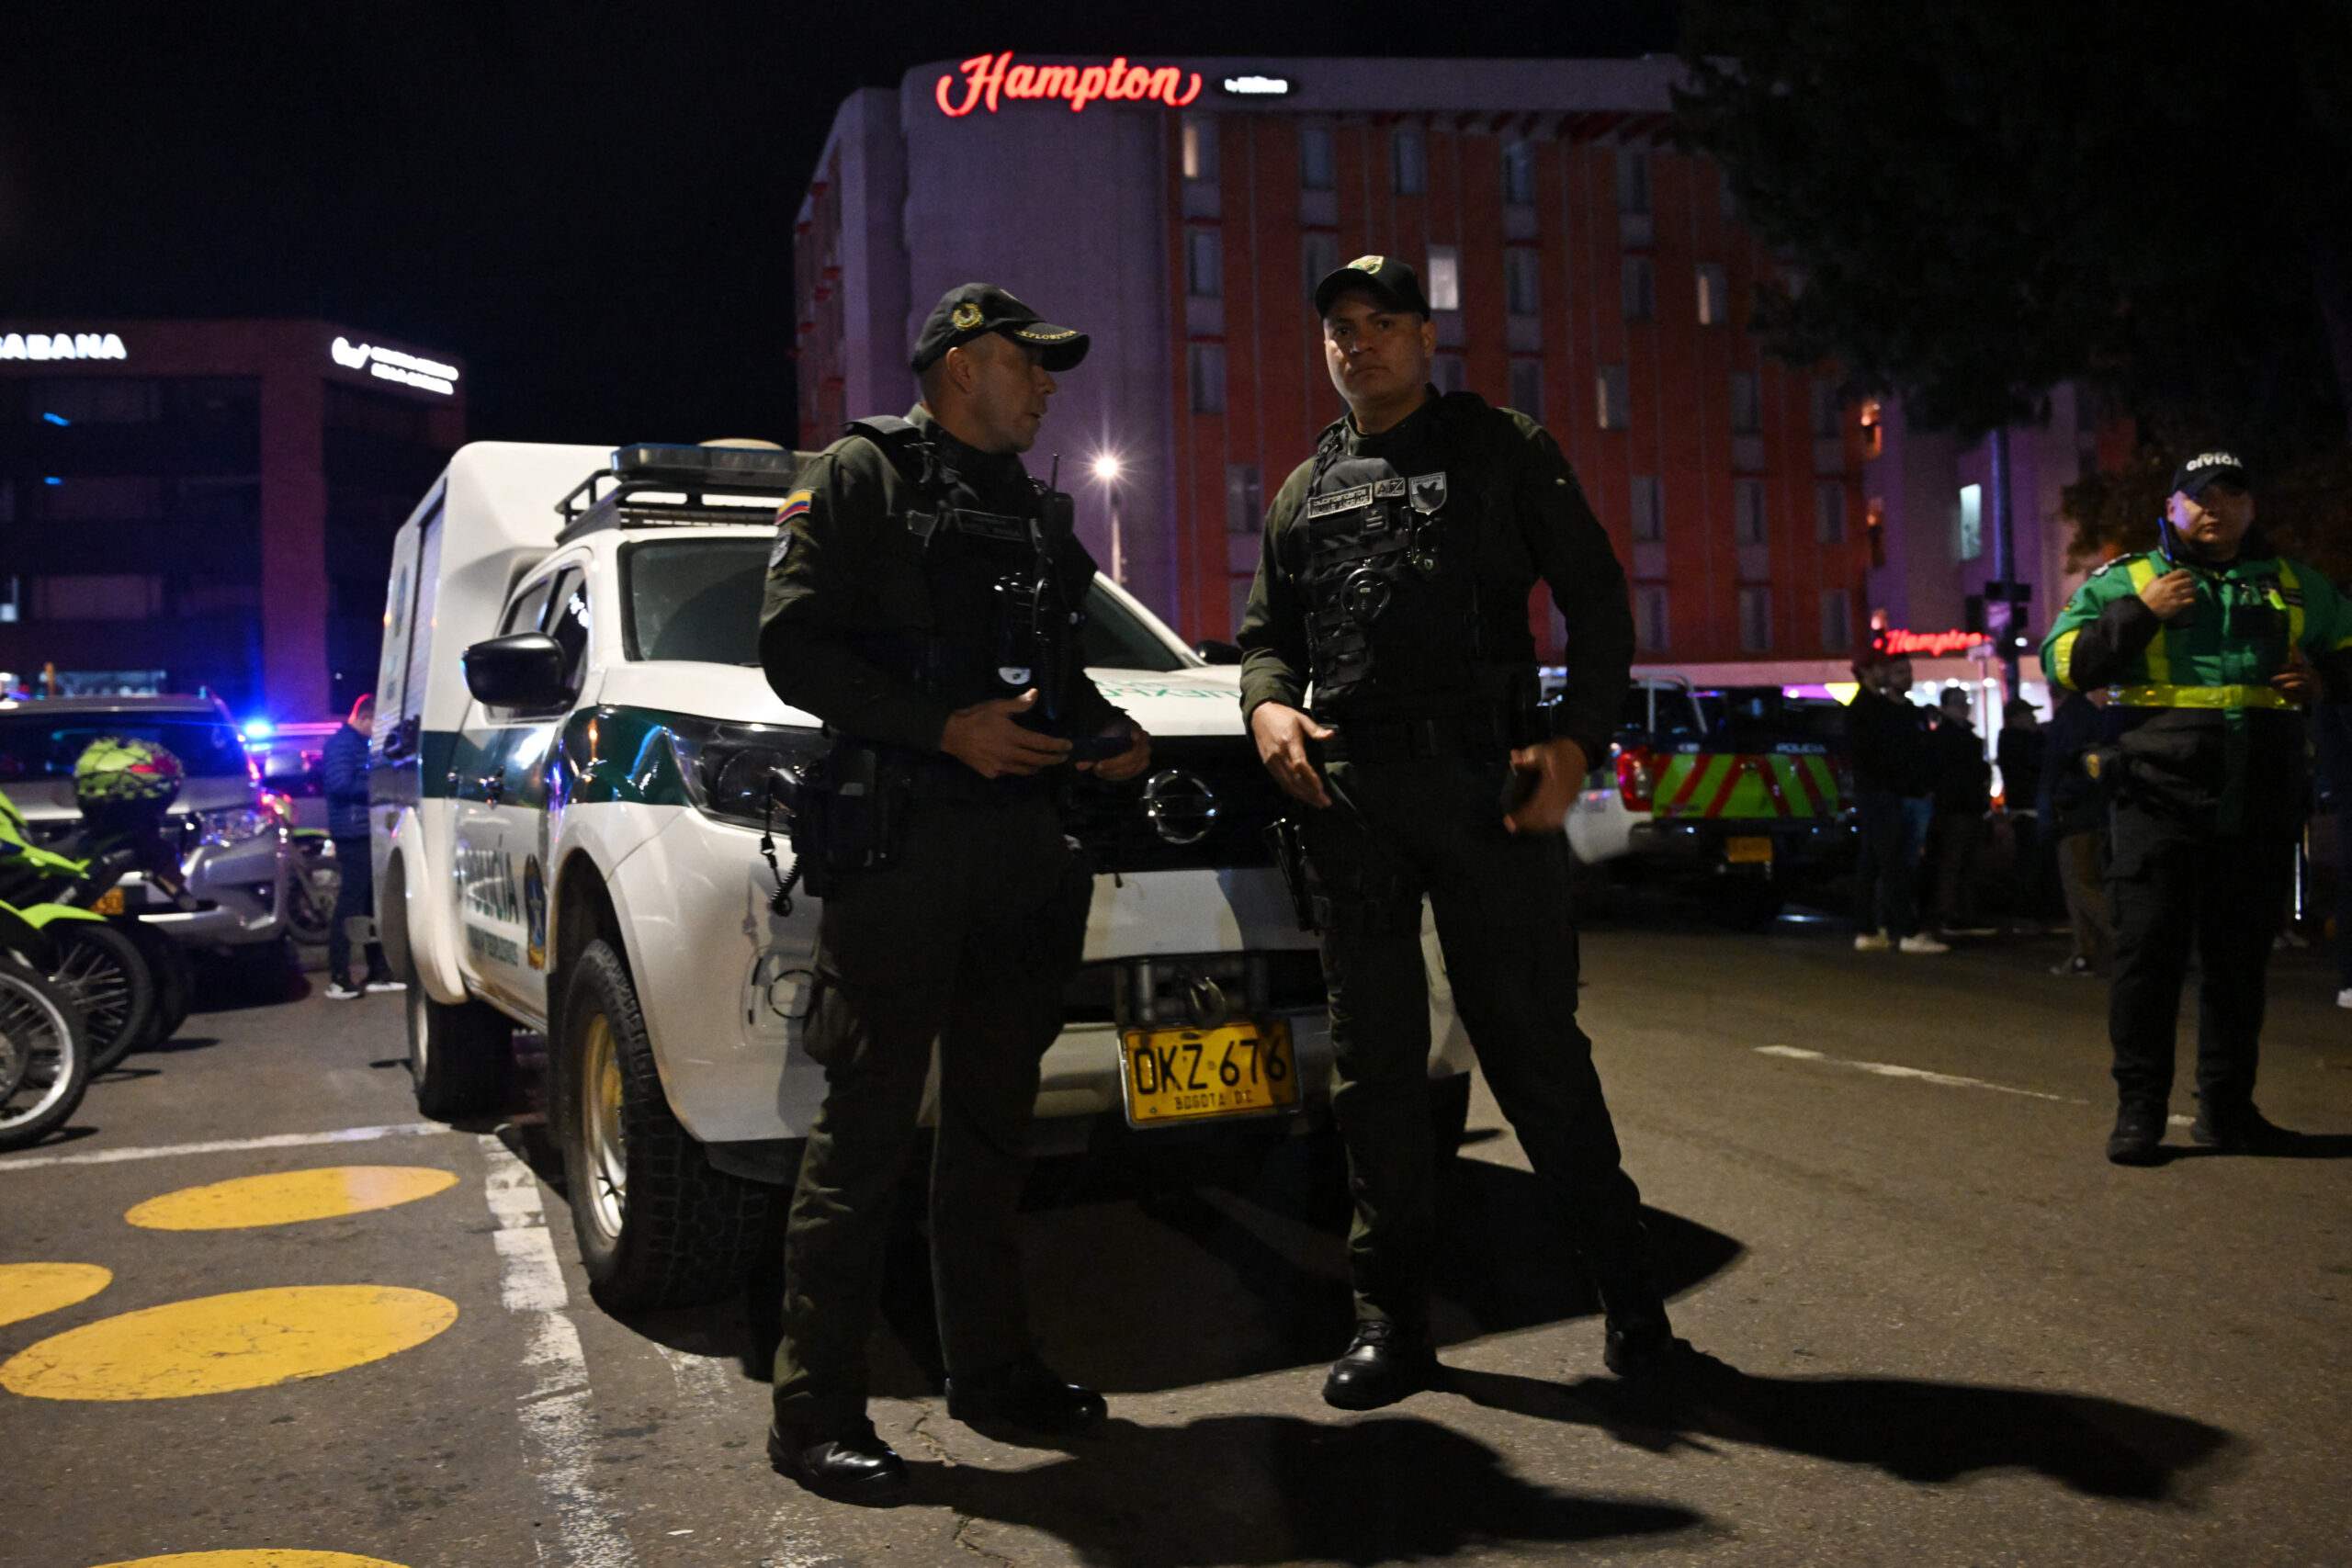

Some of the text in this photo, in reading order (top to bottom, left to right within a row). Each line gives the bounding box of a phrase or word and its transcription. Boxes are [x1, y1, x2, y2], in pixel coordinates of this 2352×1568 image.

[935, 51, 1202, 118] Hampton
[0, 333, 128, 360] ABANA
[1219, 1035, 1286, 1088] 676
